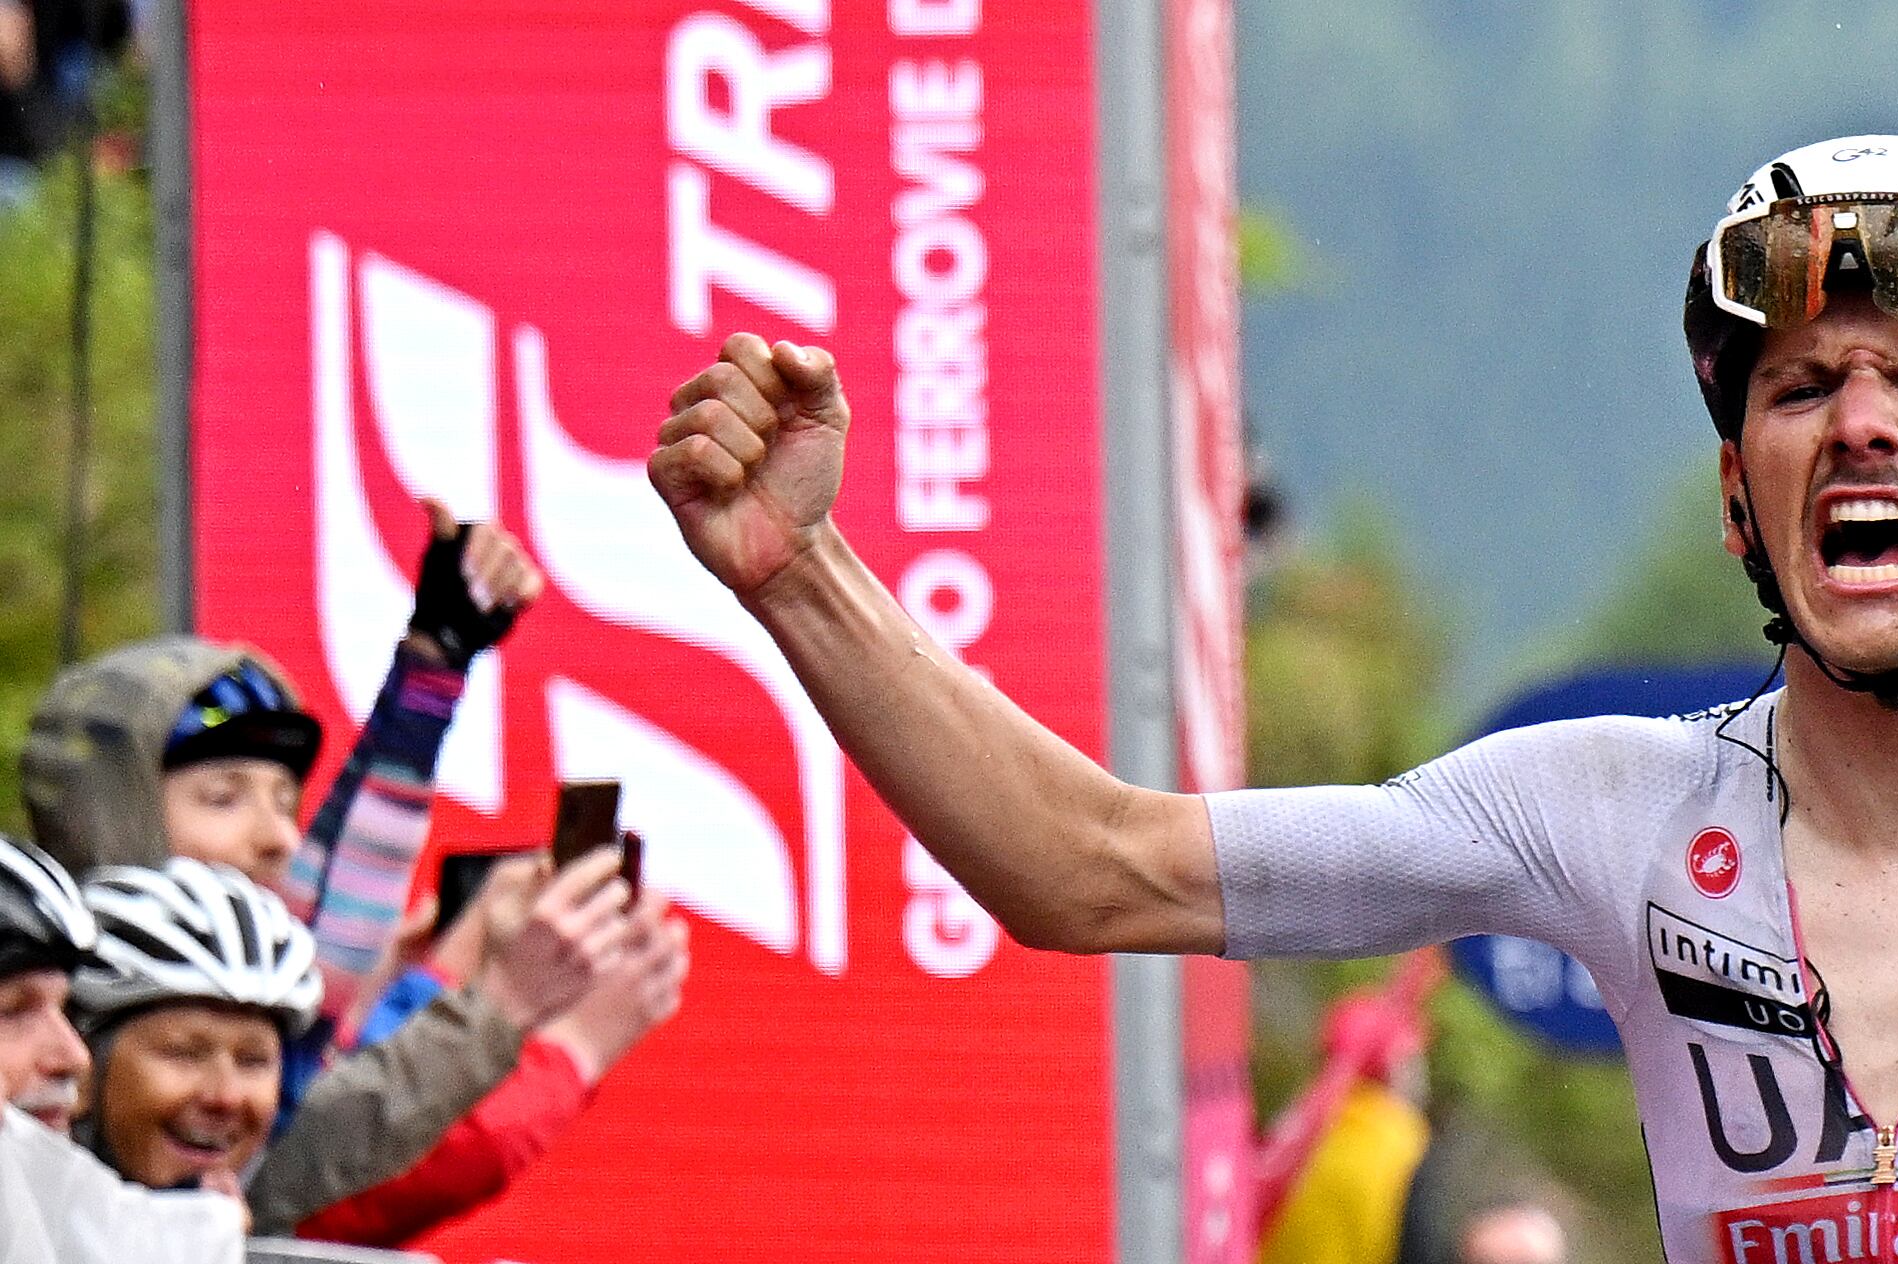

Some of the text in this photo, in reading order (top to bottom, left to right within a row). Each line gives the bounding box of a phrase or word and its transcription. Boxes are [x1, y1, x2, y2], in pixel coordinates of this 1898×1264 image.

[665, 0, 837, 338] TR
[886, 56, 993, 532] FERROVIE
[1831, 147, 1889, 162] G42
